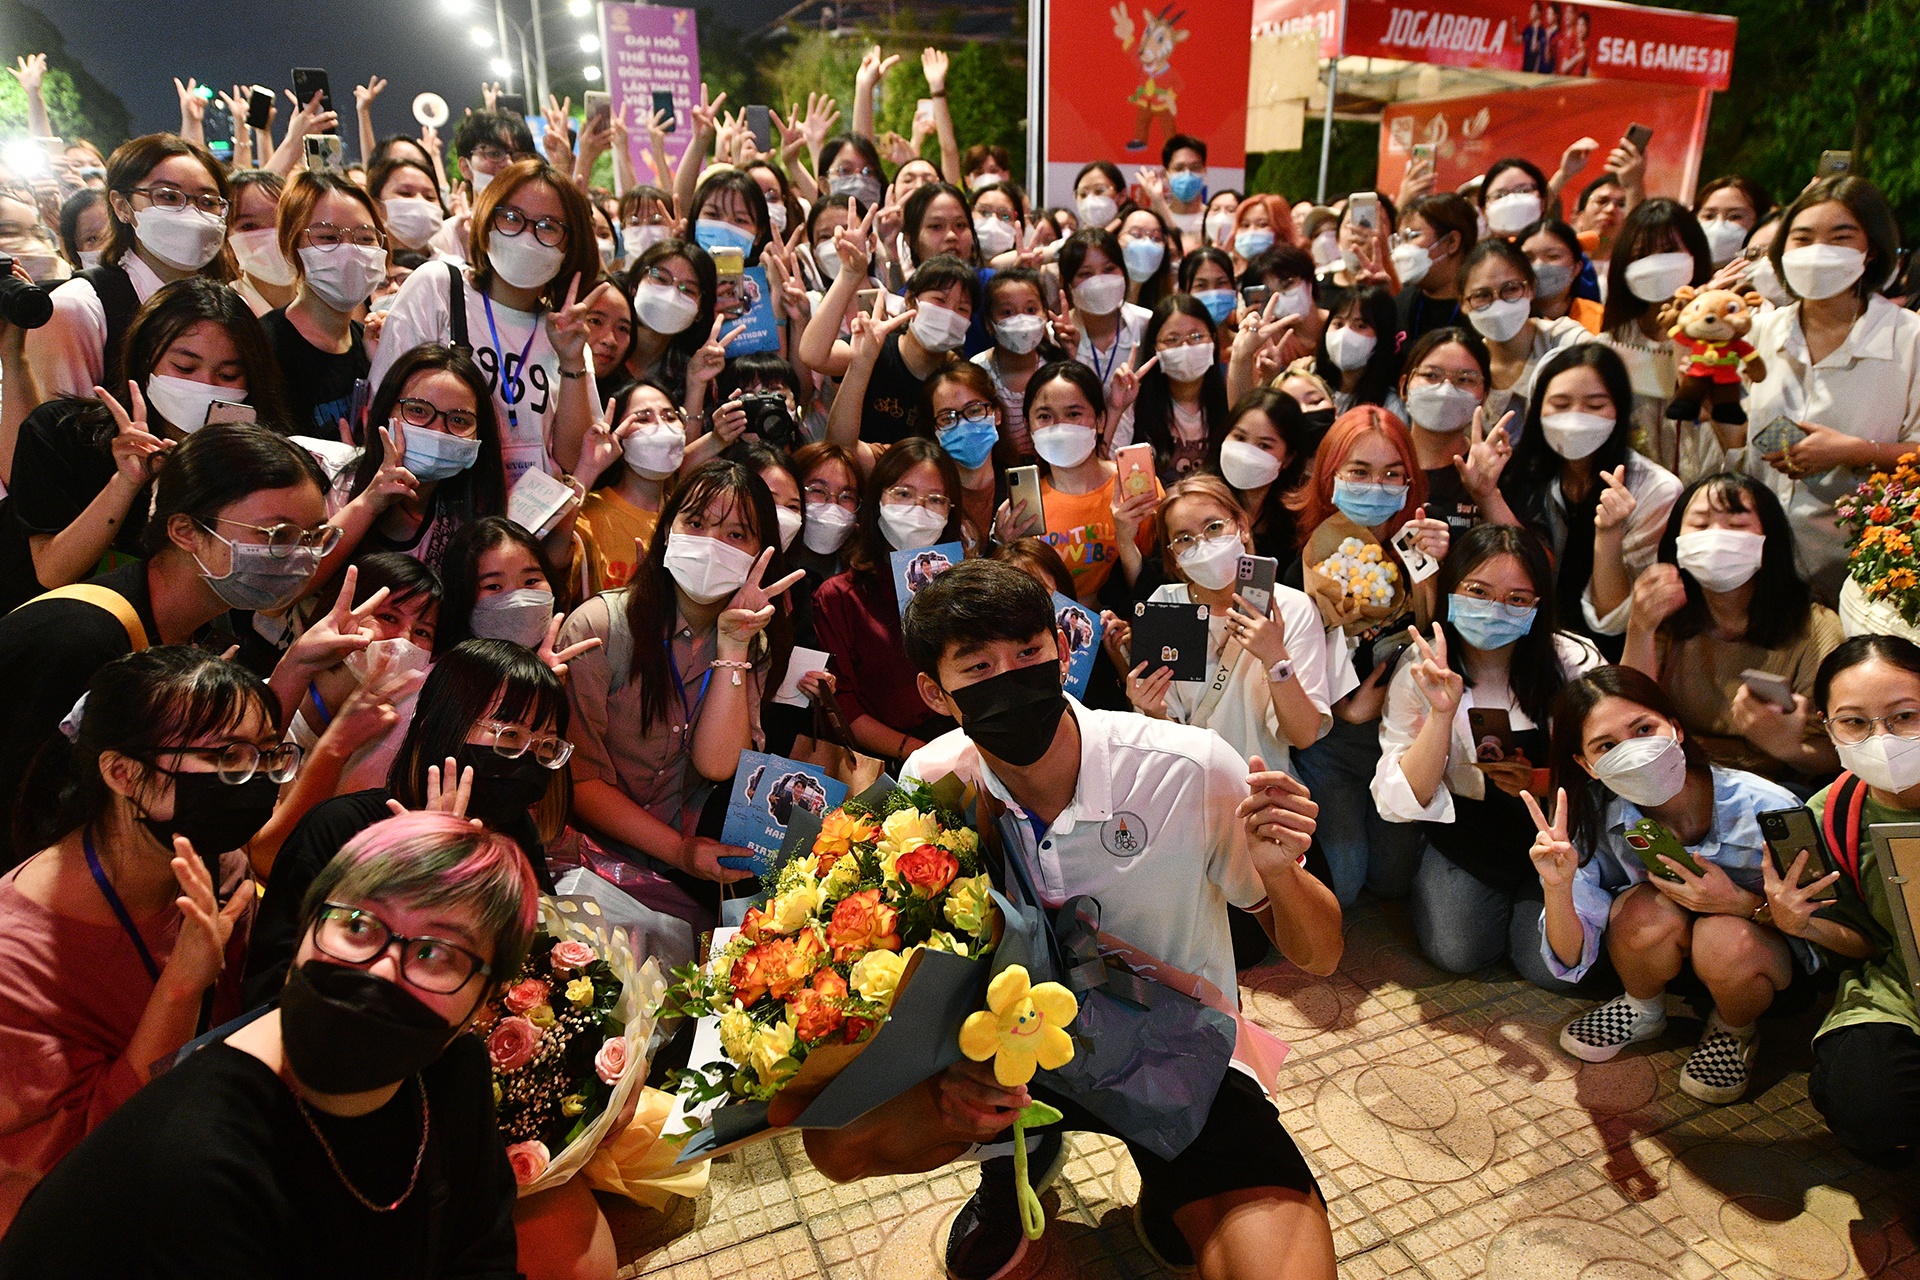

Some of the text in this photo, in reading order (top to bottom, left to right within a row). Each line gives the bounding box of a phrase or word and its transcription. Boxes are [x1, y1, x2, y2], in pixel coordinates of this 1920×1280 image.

[1379, 7, 1508, 55] JOGARBOLA
[649, 52, 689, 66] THAO
[1597, 36, 1730, 75] SEA GAMES 31
[731, 316, 757, 326] HAPPY
[1212, 664, 1229, 691] DCY
